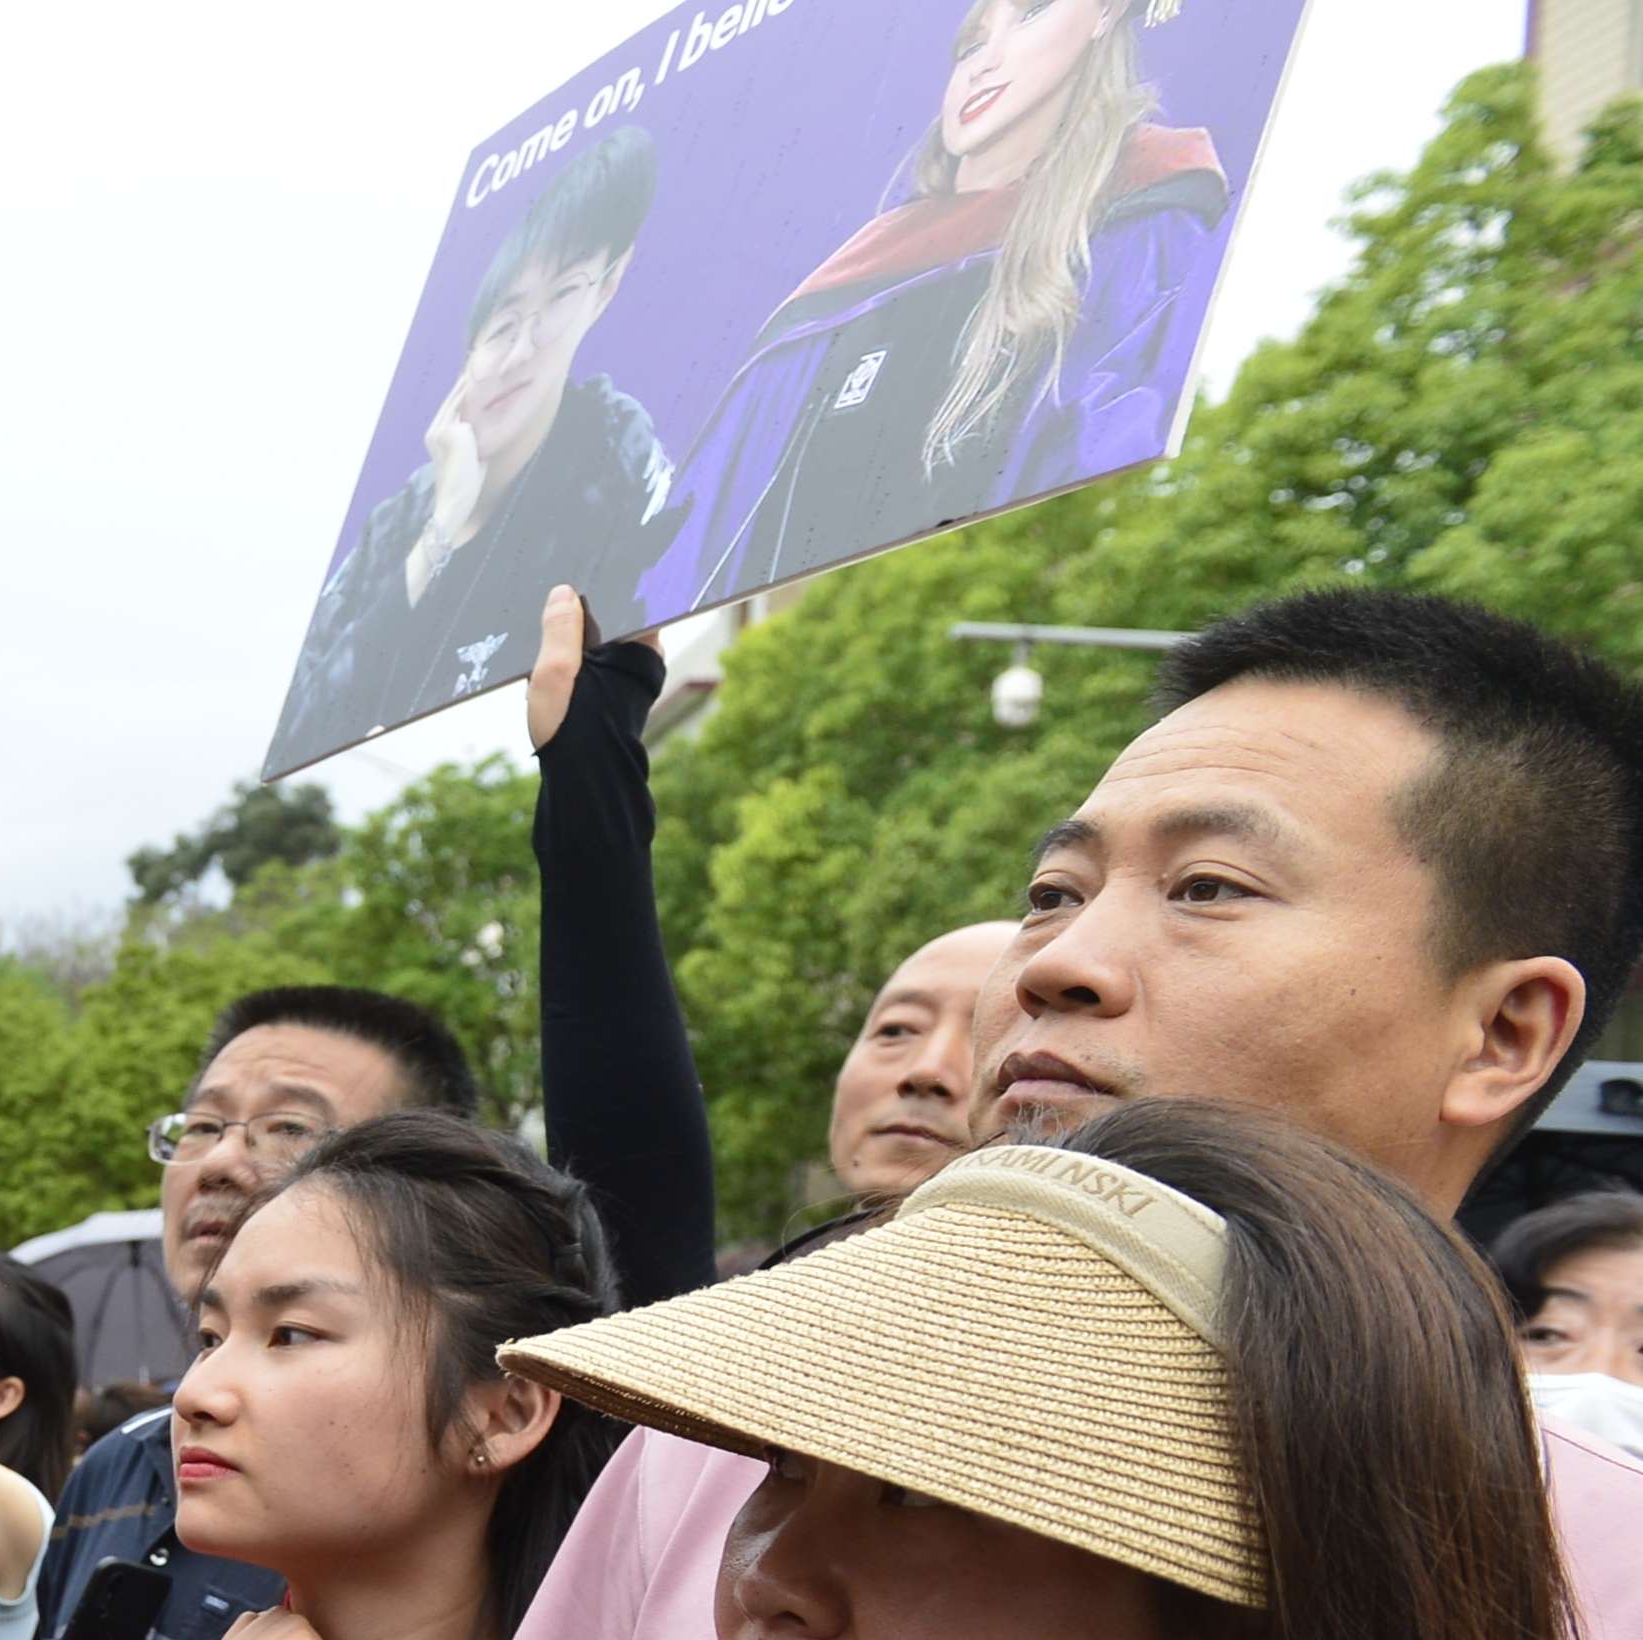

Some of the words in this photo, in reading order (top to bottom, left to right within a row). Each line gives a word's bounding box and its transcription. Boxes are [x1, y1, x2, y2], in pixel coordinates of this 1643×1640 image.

[466, 109, 578, 208] Come
[583, 67, 645, 128] on,
[654, 29, 681, 85] I
